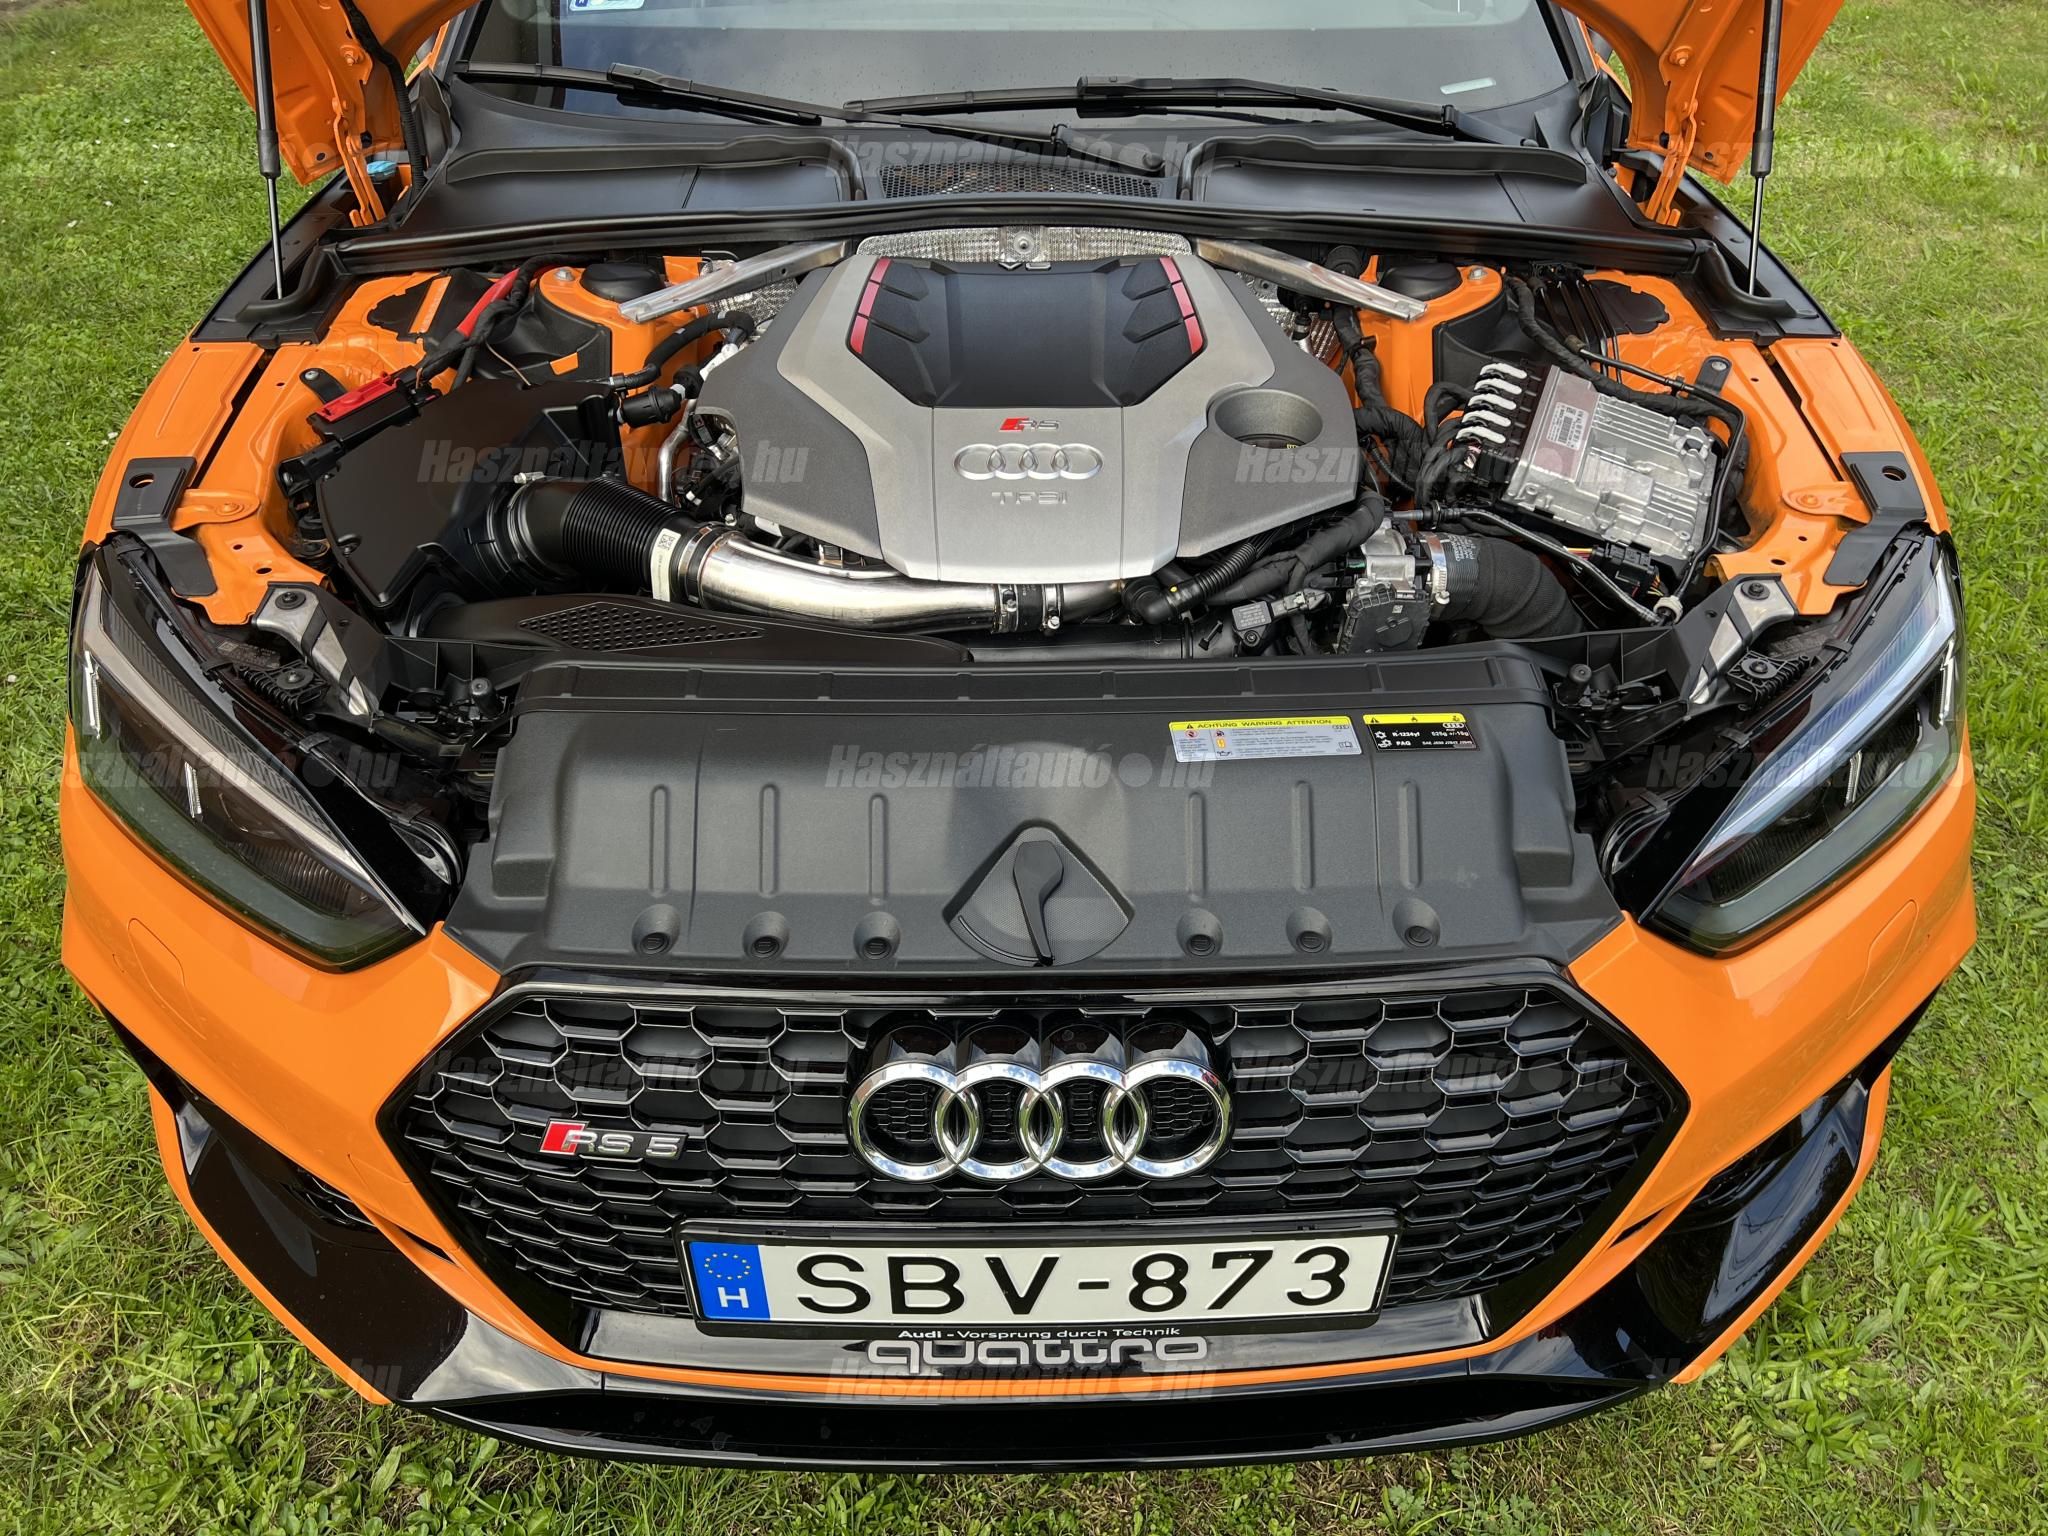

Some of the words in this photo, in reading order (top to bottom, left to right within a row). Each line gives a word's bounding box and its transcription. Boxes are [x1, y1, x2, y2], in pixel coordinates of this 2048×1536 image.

[1014, 419, 1060, 431] RS
[991, 491, 1067, 505] TFSI
[561, 1129, 635, 1156] RS
[645, 1135, 682, 1157] 5
[795, 1244, 1349, 1316] SBV-873
[718, 1285, 749, 1309] H
[898, 1330, 942, 1339] Audi
[957, 1330, 1052, 1341] Vorsprung
[1056, 1329, 1108, 1338] durch
[1112, 1327, 1181, 1336] Technik
[868, 1335, 1208, 1374] quattro
